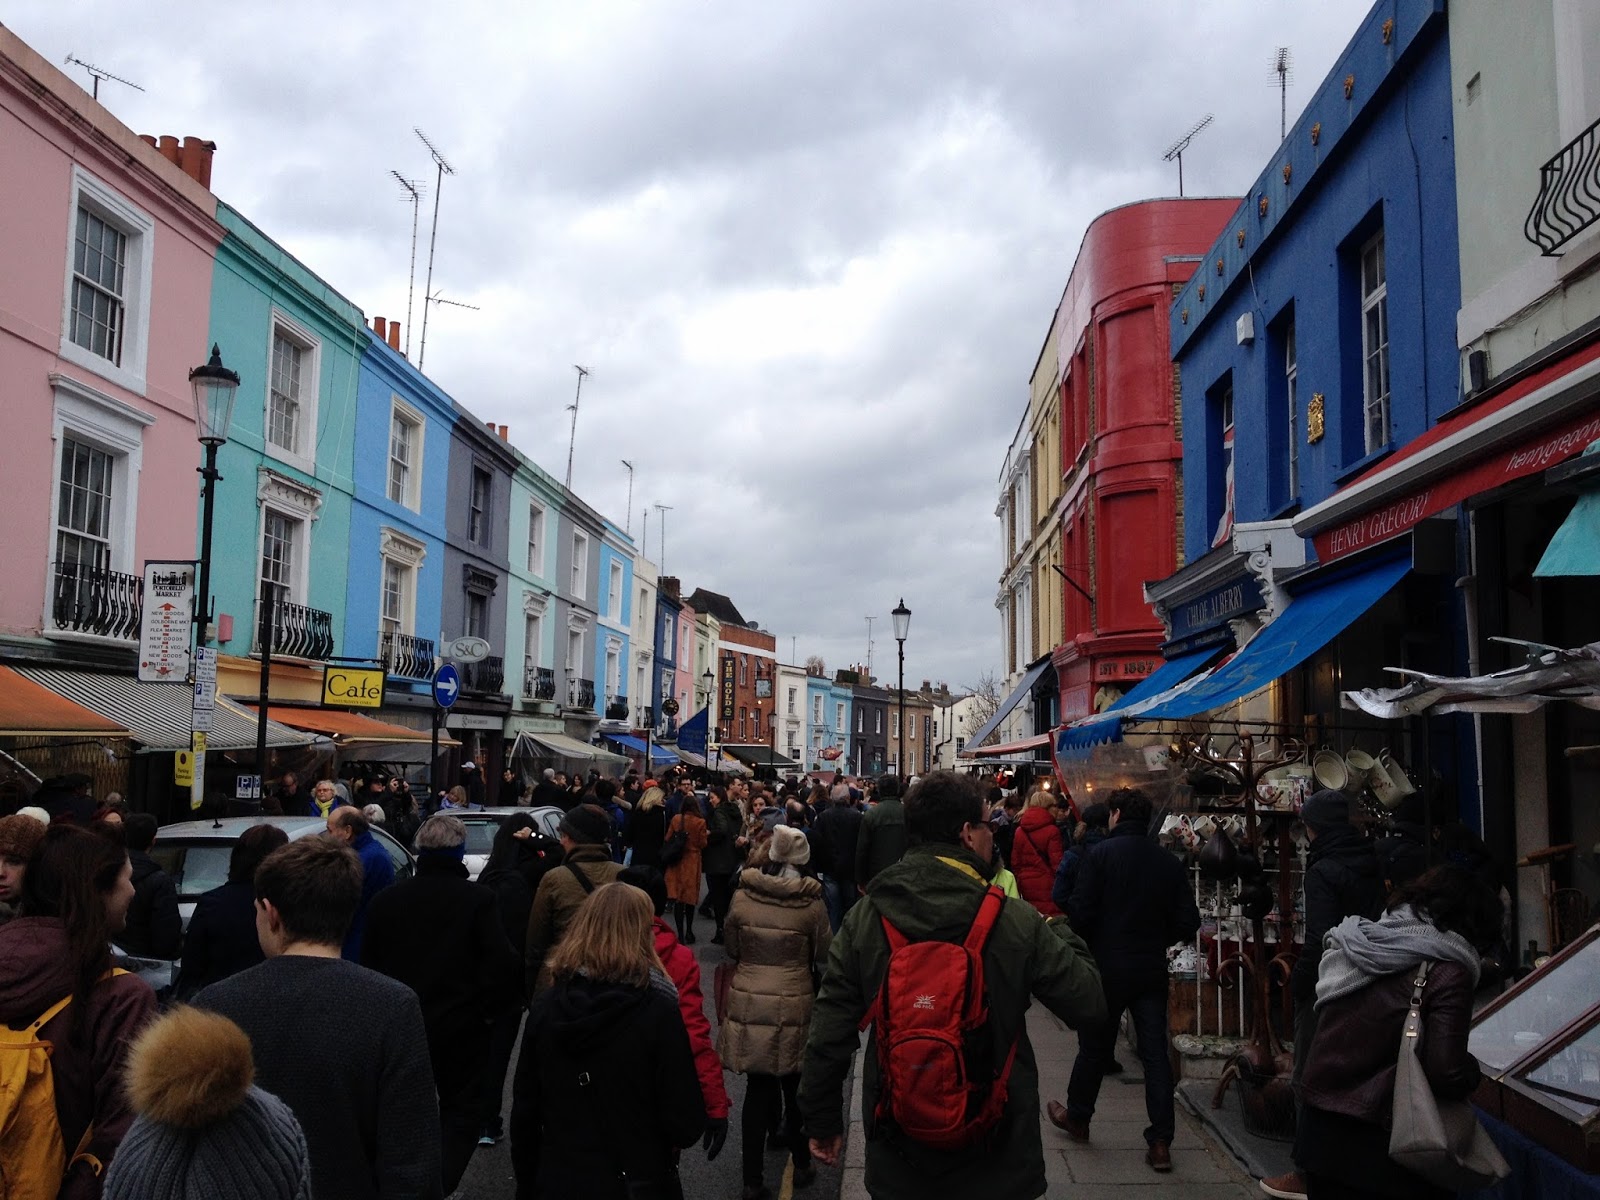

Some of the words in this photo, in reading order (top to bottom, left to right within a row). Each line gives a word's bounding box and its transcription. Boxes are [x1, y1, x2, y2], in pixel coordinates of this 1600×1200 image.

[1505, 419, 1600, 472] henrygregory
[1330, 518, 1369, 555] HENRY
[1369, 490, 1434, 539] GREGORY
[1186, 599, 1208, 628] CHLOE
[1211, 583, 1243, 620] ALBERRY
[455, 642, 483, 658] S&C
[725, 660, 733, 679] THE
[328, 674, 380, 699] Café
[724, 681, 733, 706] GOLD
